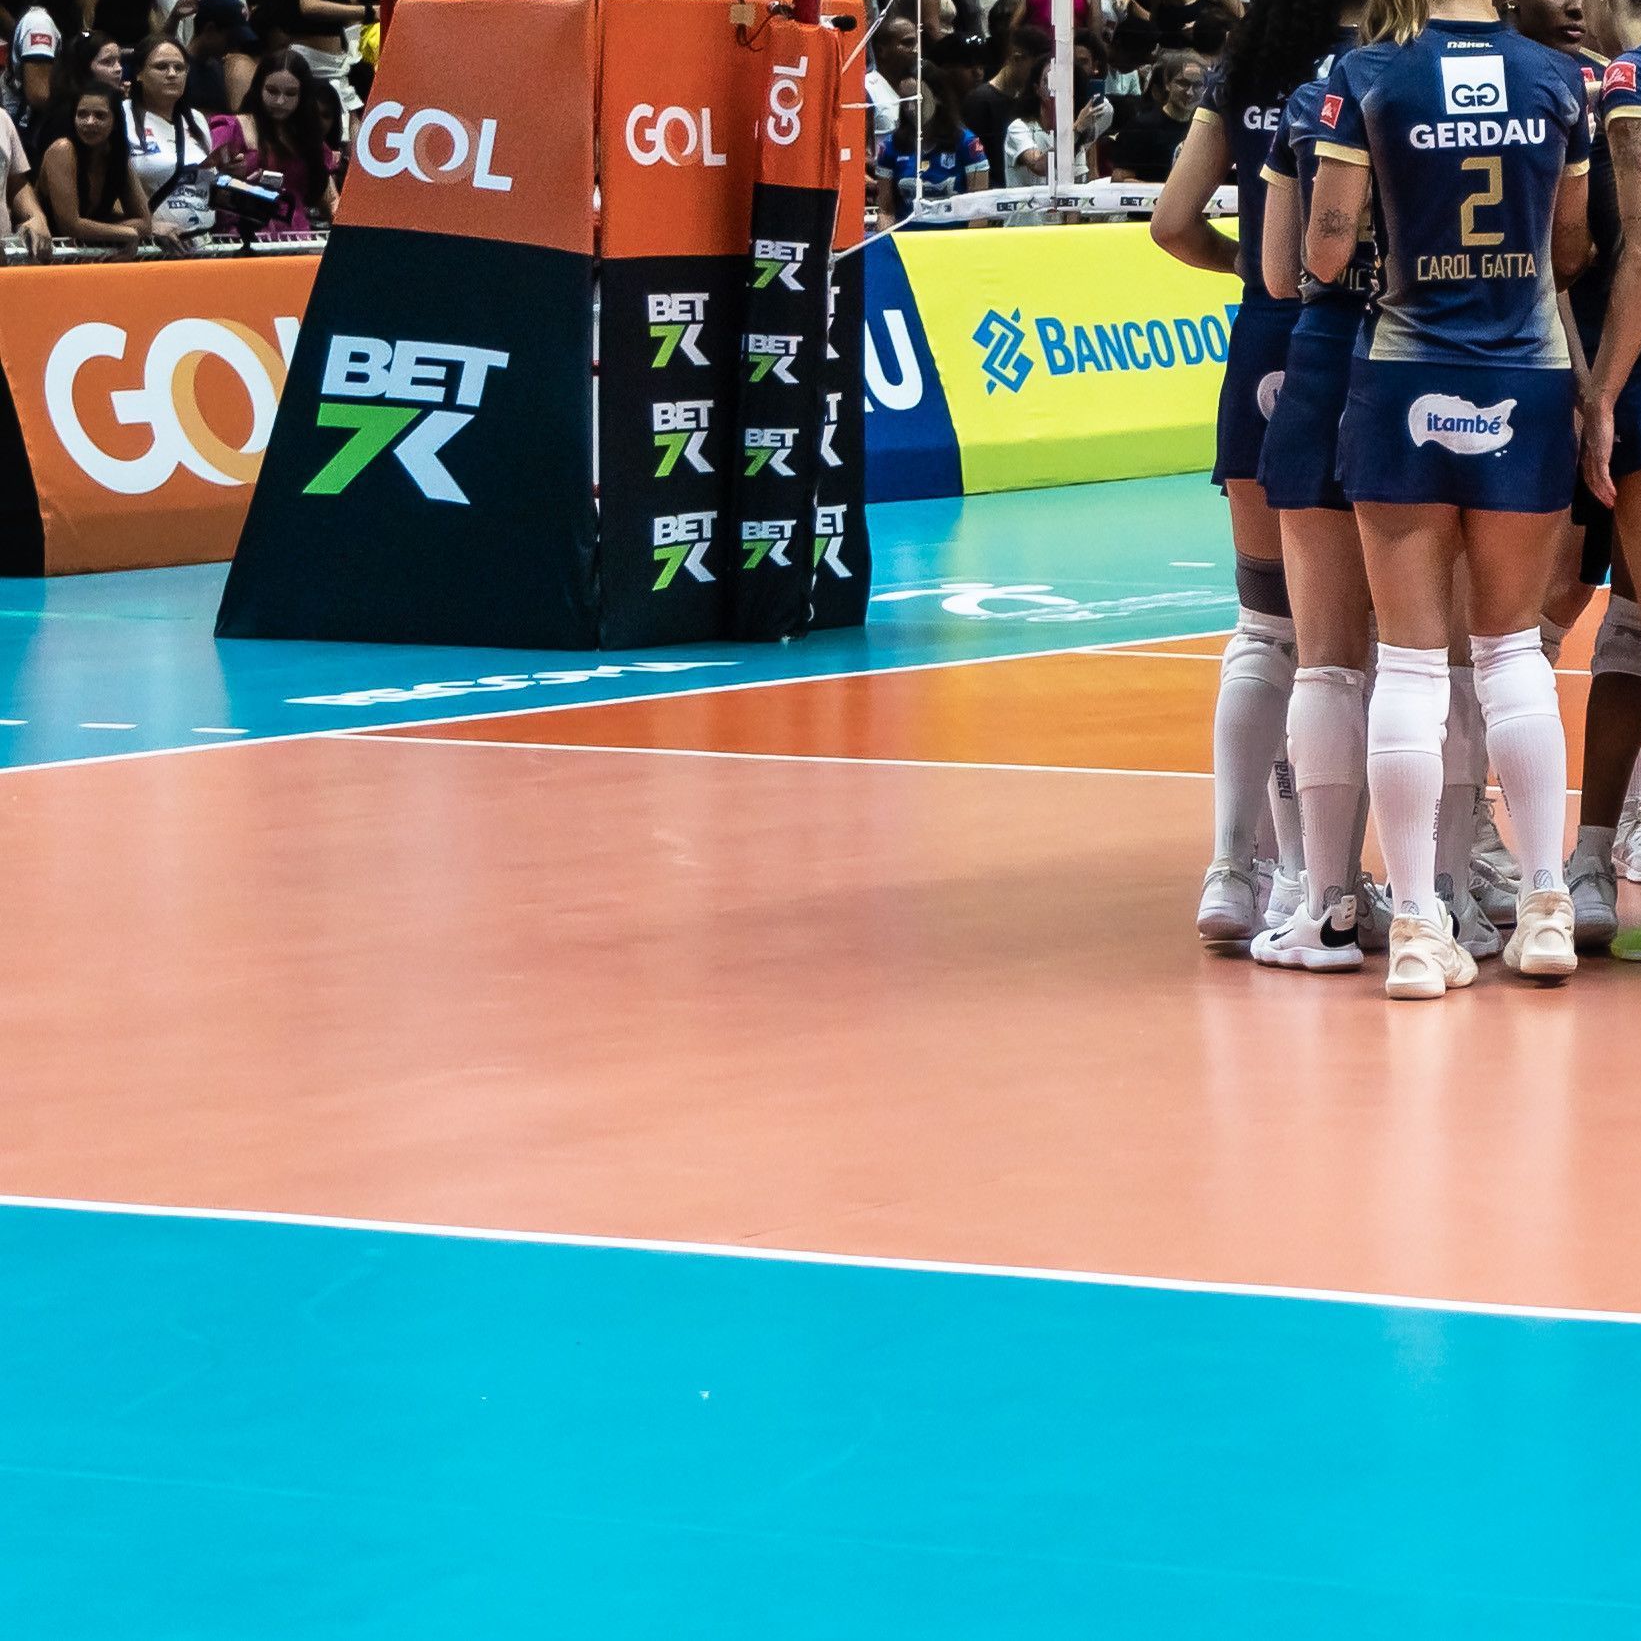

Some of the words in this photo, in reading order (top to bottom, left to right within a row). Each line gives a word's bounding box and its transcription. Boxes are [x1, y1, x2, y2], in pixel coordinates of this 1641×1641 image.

[766, 55, 808, 146] GOL
[356, 100, 514, 192] GOL
[625, 103, 727, 167] GOL
[1409, 118, 1546, 150] GERDAU
[1460, 156, 1505, 247] 2
[754, 239, 810, 261] BET
[1417, 253, 1477, 281] CAROL
[1481, 252, 1538, 279] GATTA
[648, 291, 710, 323] BET
[748, 333, 803, 356] BET
[1035, 315, 1174, 376] BANCO
[1180, 313, 1228, 365] DO
[320, 335, 510, 407] BET
[44, 315, 301, 495] GO
[652, 399, 715, 432] BET
[744, 427, 800, 449] BET
[1426, 408, 1501, 437] itambé
[653, 510, 718, 544] BET
[741, 519, 797, 541] BET
[815, 503, 848, 537] ET
